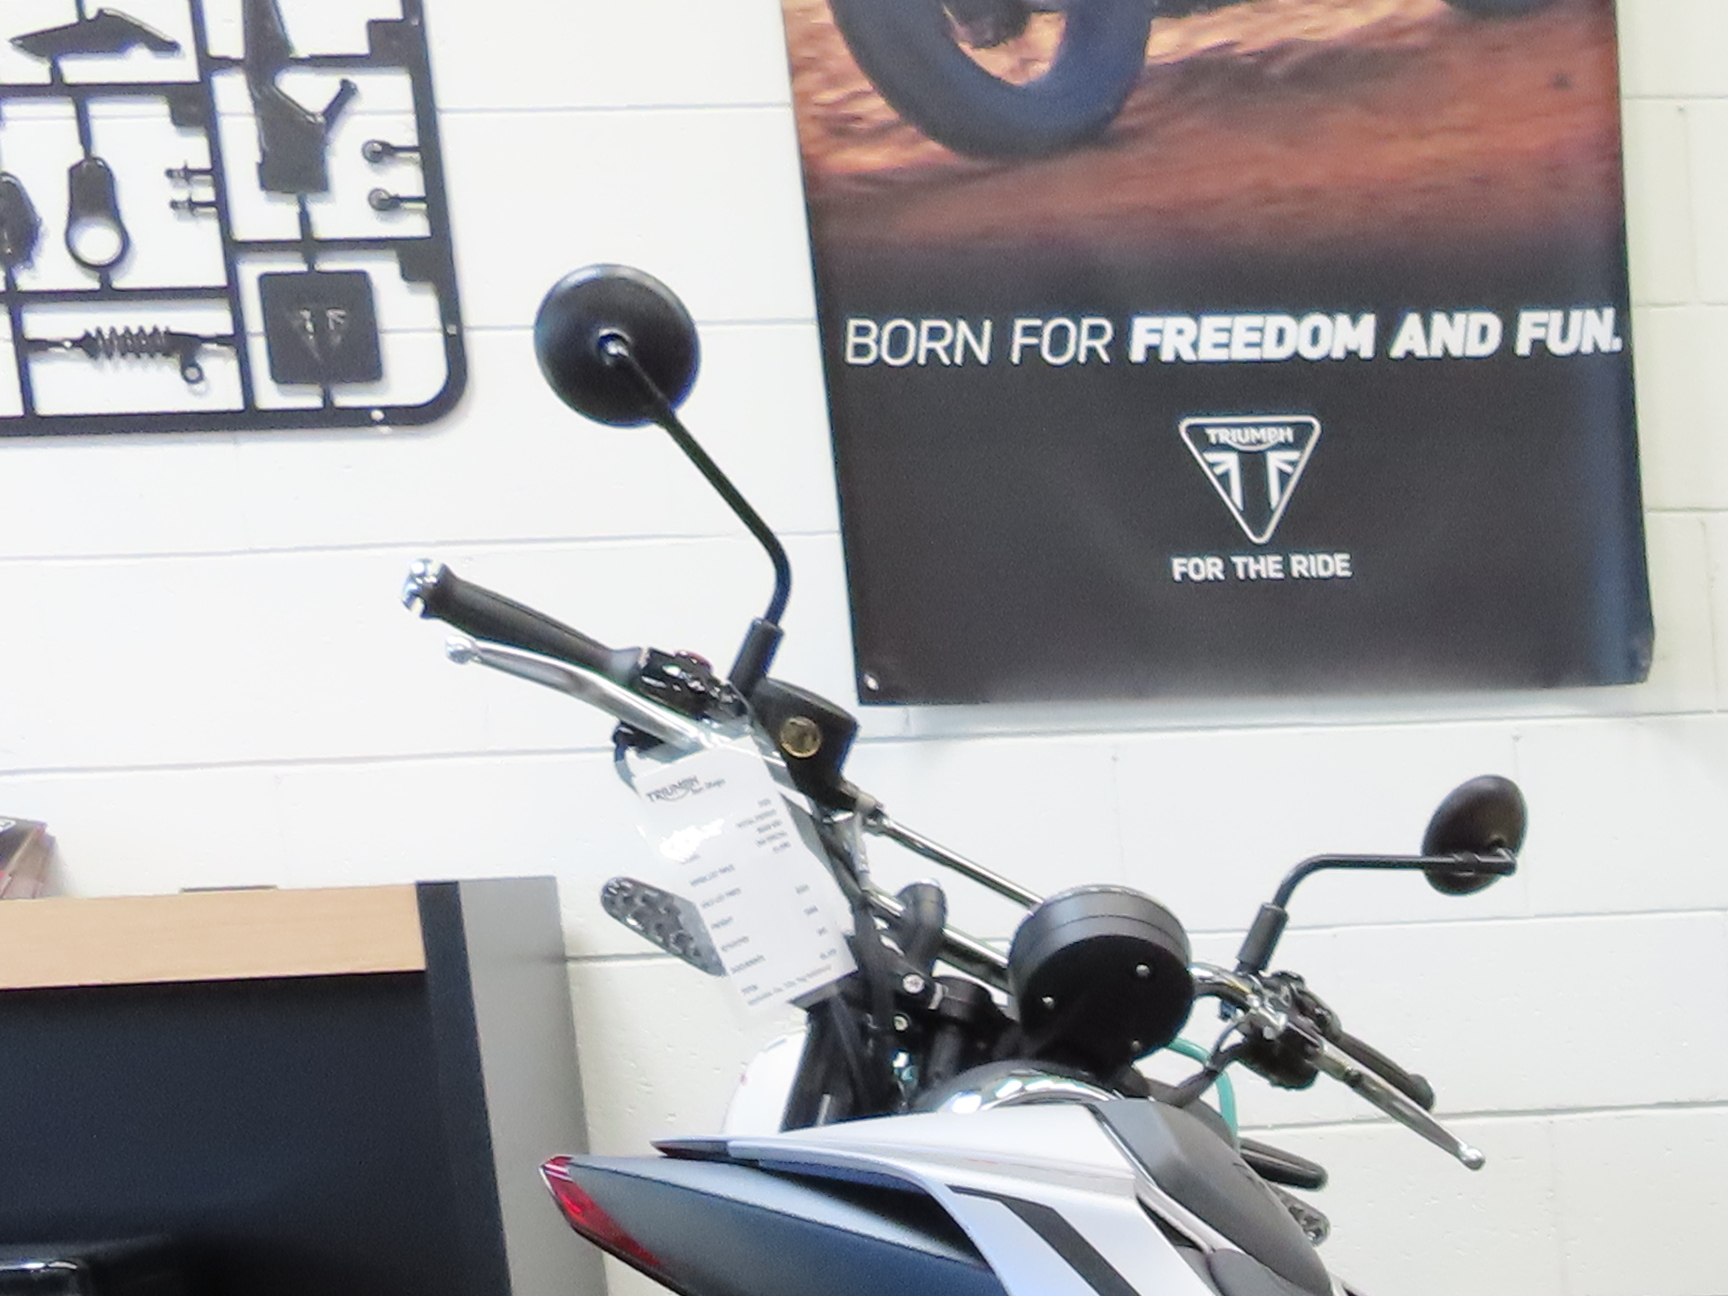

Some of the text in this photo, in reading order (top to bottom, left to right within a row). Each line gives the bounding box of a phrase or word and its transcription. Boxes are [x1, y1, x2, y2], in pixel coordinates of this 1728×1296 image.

[844, 307, 1622, 367] BORN FOR FREEDOM AND FUN.
[1205, 427, 1294, 451] TRIUMPH
[1171, 553, 1352, 582] FOR THE RIDE
